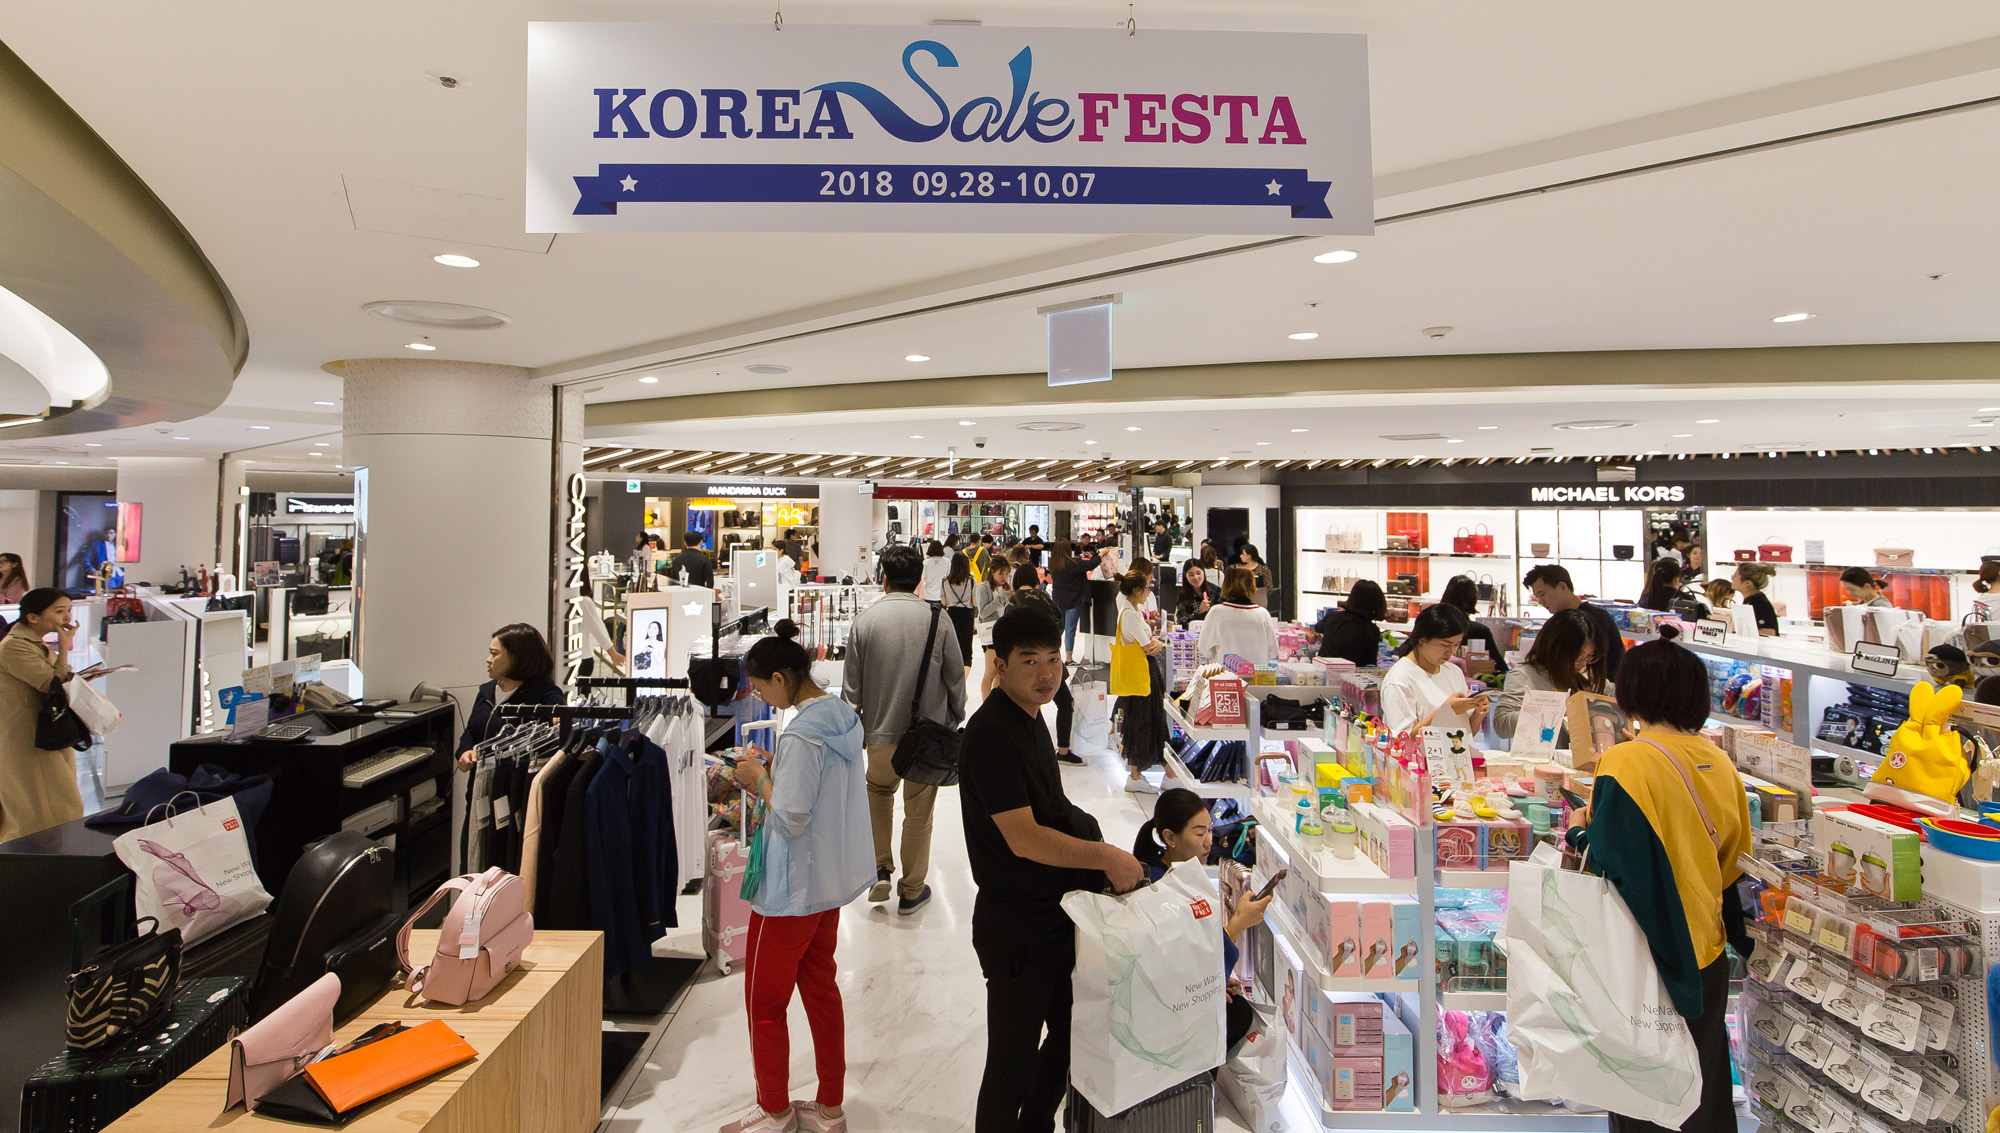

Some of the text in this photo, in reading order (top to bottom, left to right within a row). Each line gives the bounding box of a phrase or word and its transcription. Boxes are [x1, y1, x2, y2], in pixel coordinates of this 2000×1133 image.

[593, 40, 1307, 146] KOREA Sale FESTA
[819, 171, 893, 198] 2018
[707, 486, 787, 496] MANDARINA DUCK
[1531, 485, 1686, 502] MICHAEL KORS
[570, 472, 586, 589] CALVIN
[567, 595, 584, 686] KLEIN
[1216, 693, 1238, 706] 25%
[1216, 705, 1239, 714] SALE
[1427, 746, 1443, 755] 2+1
[223, 865, 240, 876] New
[215, 876, 233, 888] New
[1191, 901, 1208, 911] DUTY
[1194, 907, 1211, 917] FREE
[1185, 981, 1203, 995] New
[1172, 984, 1222, 1013] New Shopping
[1630, 1015, 1652, 1029] New
